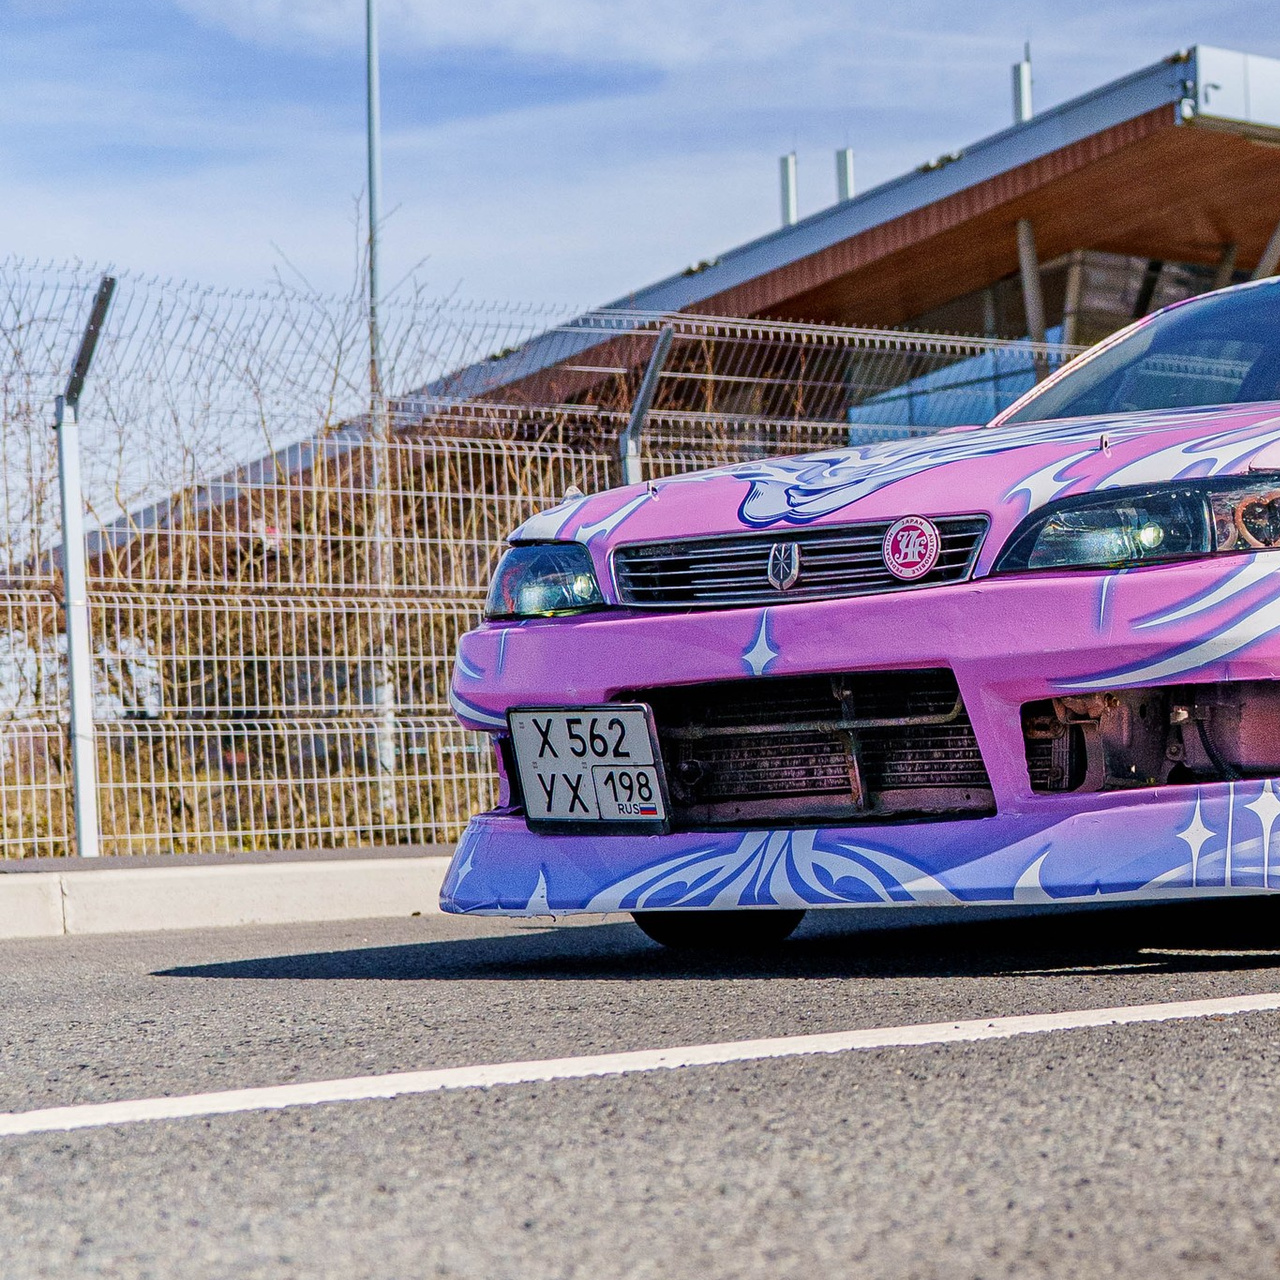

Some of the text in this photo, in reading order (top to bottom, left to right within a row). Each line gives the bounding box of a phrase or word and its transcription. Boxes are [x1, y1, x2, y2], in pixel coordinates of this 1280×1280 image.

[901, 519, 924, 527] JAPAN
[885, 532, 903, 574] FEDERATION
[911, 533, 935, 574] AUTOMOBILE
[566, 718, 630, 758] 562
[603, 771, 653, 802] 198
[617, 803, 640, 815] RUS
